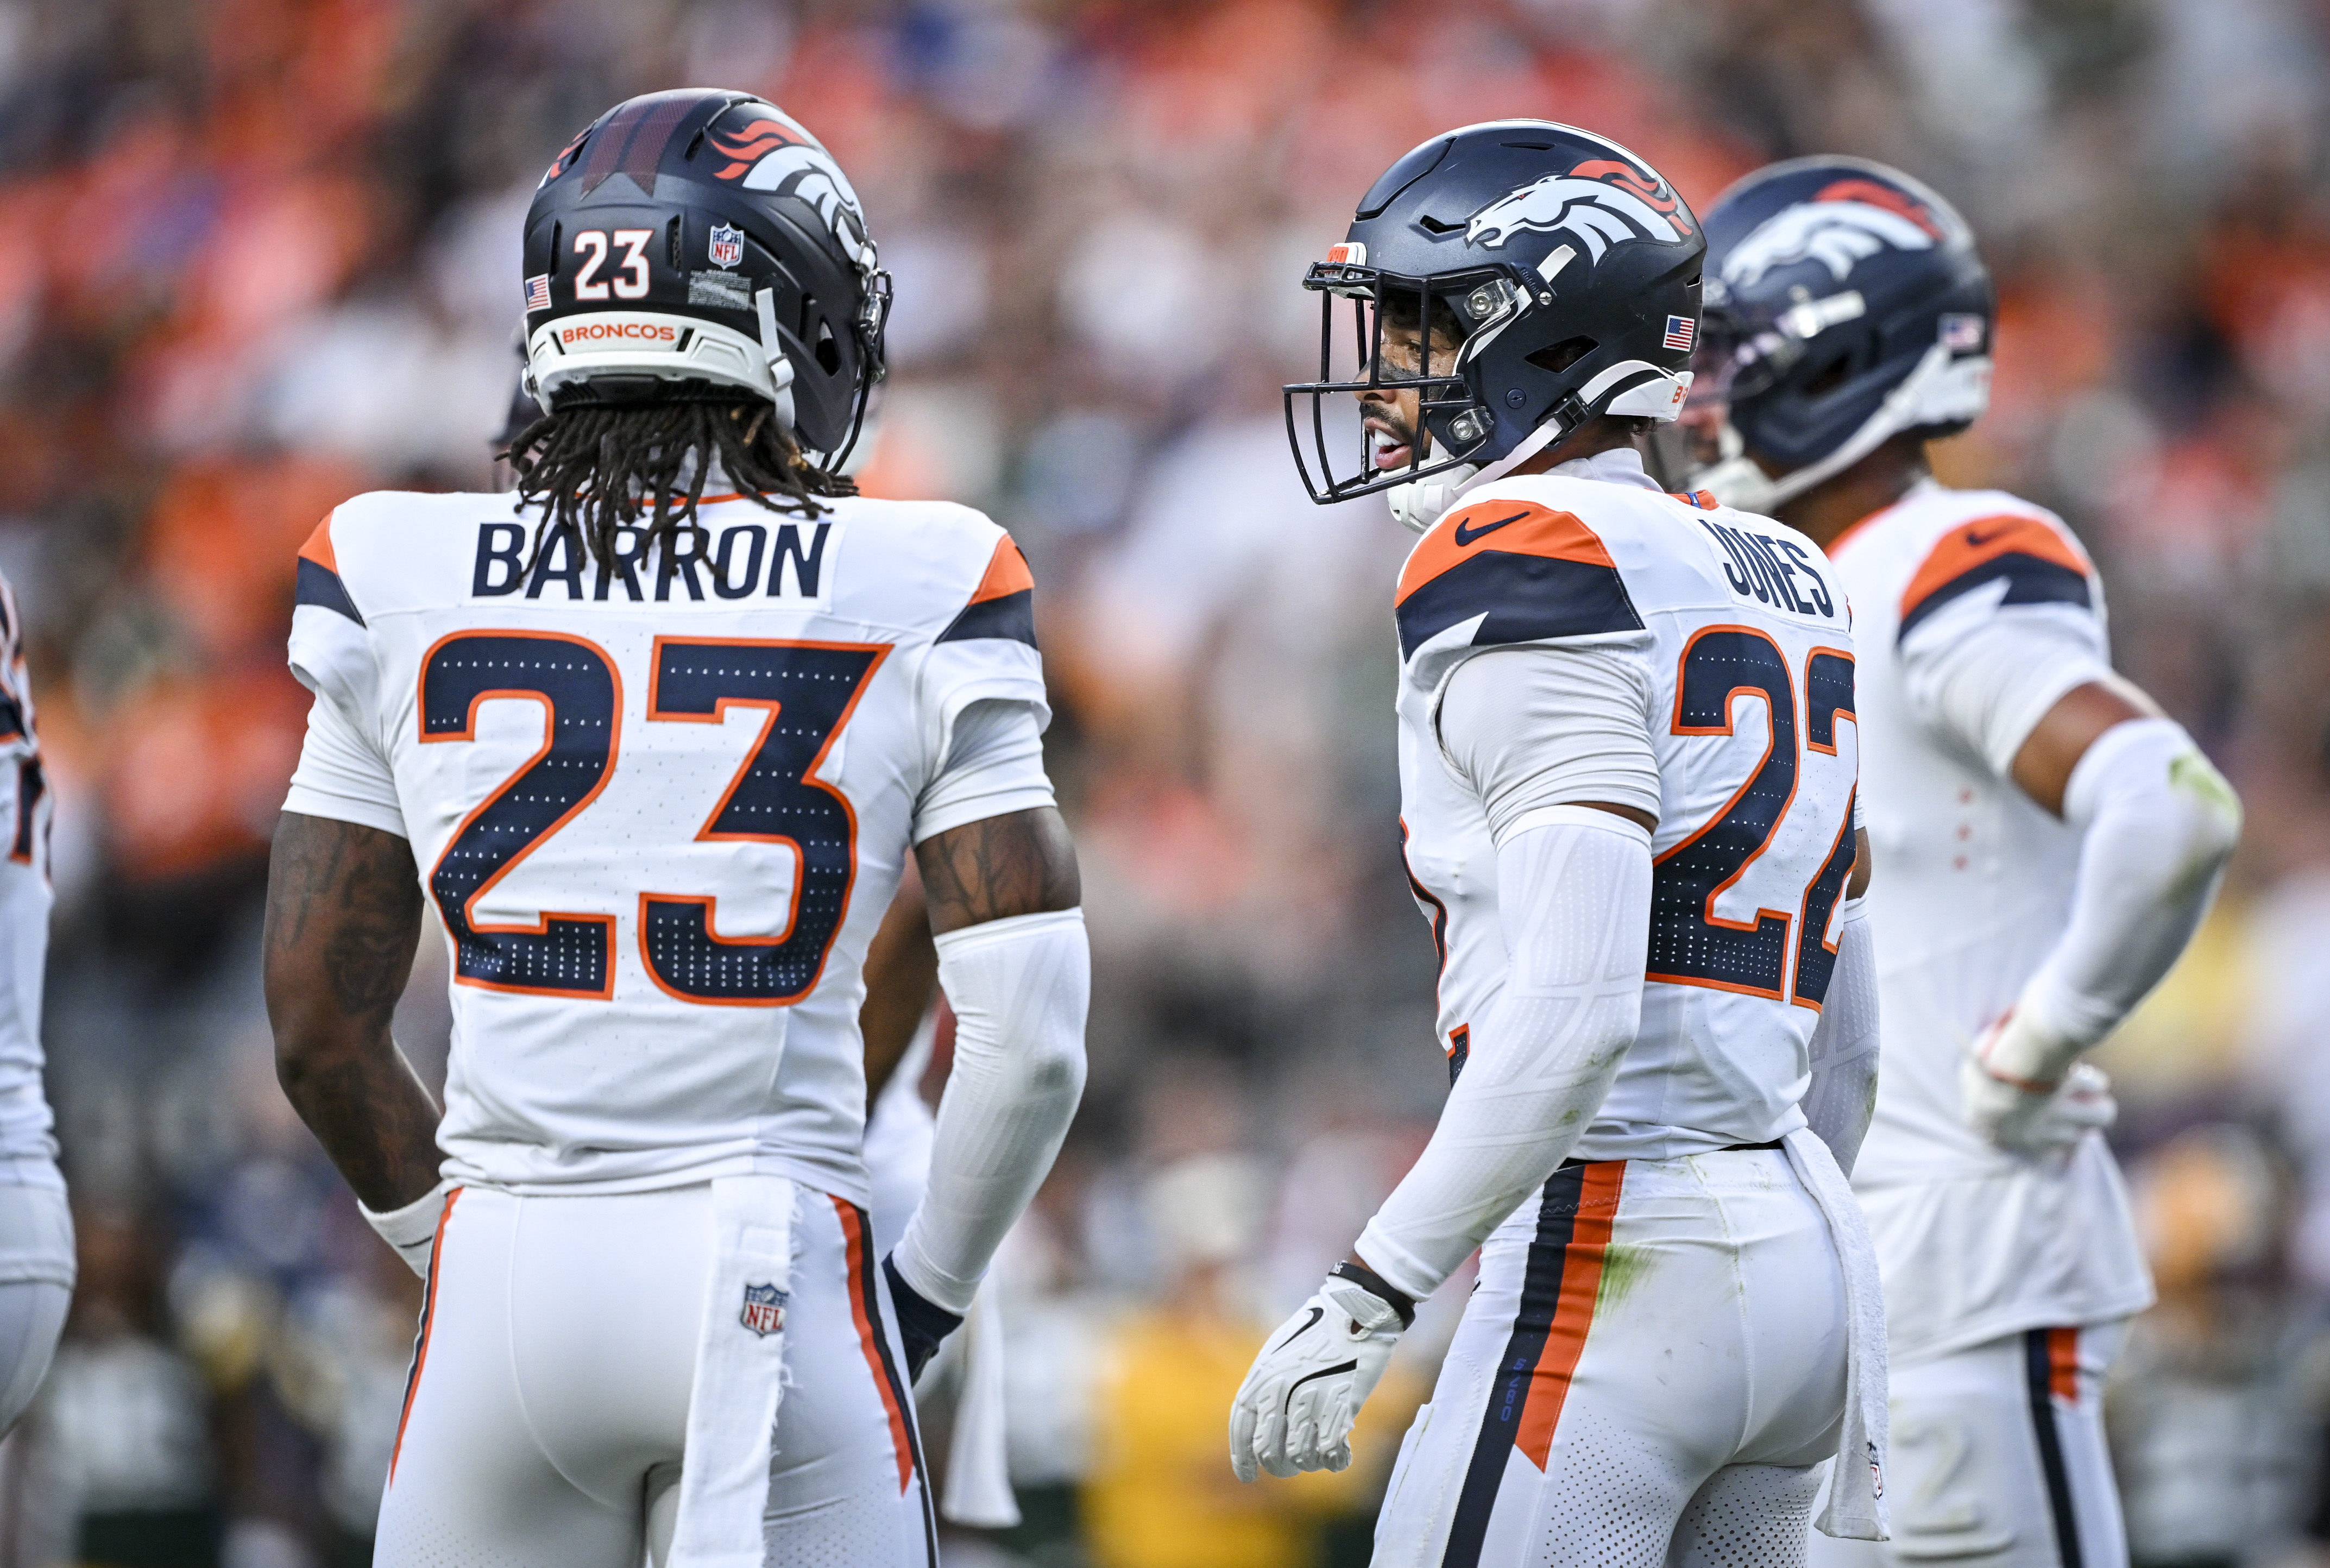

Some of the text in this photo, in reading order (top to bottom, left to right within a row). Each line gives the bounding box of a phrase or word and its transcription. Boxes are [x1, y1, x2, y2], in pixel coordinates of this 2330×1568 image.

[574, 229, 654, 300] 23
[715, 243, 737, 261] NFL
[563, 324, 675, 343] BRONCOS
[472, 522, 832, 602] BARRON
[1697, 519, 1835, 618] JONES
[417, 628, 896, 1007] 23
[1645, 624, 1859, 1014] 22
[746, 1304, 783, 1331] NFL
